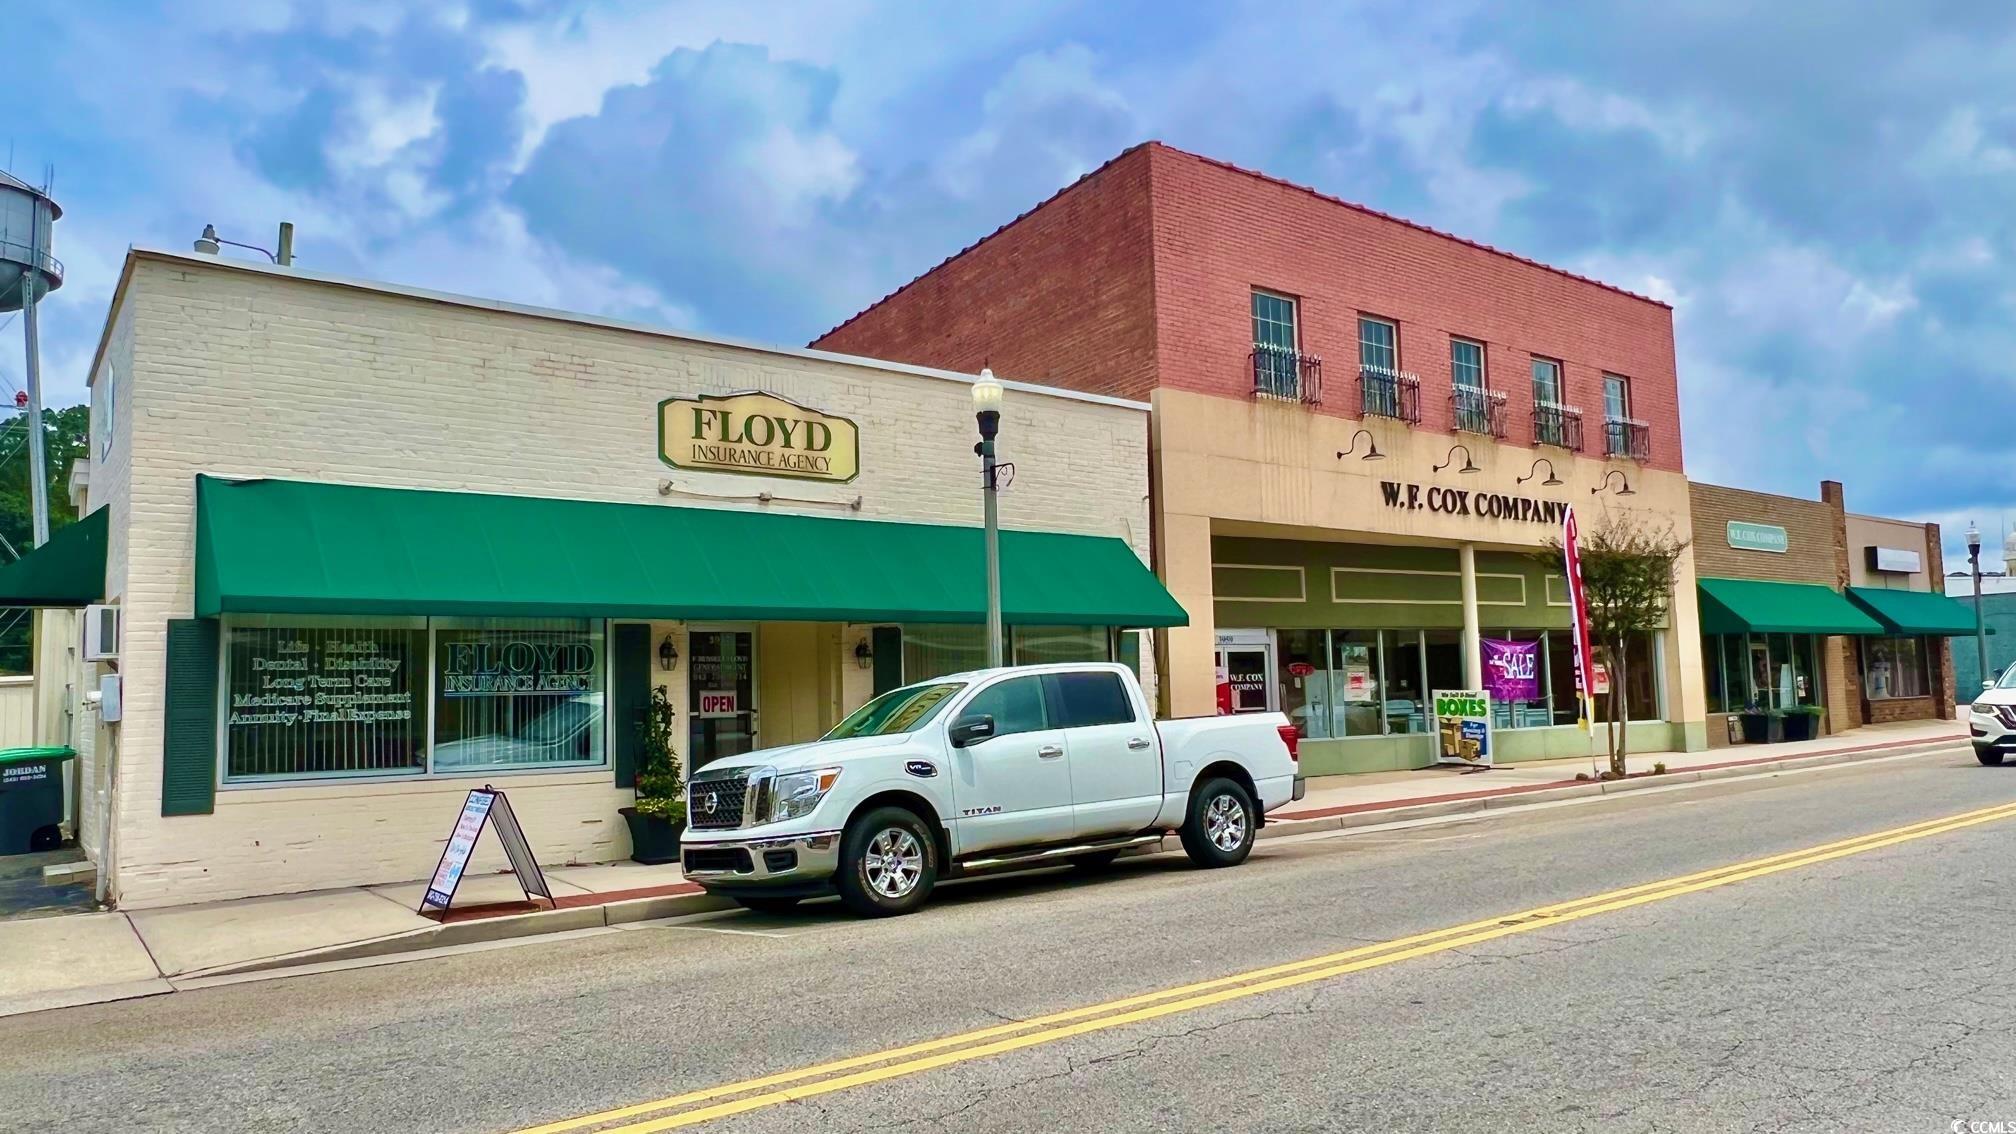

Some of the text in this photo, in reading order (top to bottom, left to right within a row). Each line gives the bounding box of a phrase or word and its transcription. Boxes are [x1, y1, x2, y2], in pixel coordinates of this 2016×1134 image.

[691, 407, 832, 452] FLOYD
[692, 444, 832, 472] INSURANCE AGENCY
[1380, 481, 1570, 526] W.F. COX COMPANY
[277, 641, 379, 653] Life Health
[252, 657, 401, 673] Dental Disability
[444, 641, 596, 675] FLOYD
[1503, 652, 1534, 679] SALE
[263, 674, 391, 691] Long Term Care
[444, 674, 596, 692] INSURANCE AGENCY
[1246, 673, 1264, 682] COX
[1230, 683, 1263, 691] COMPANY
[233, 691, 412, 707] Medicare Supplement
[703, 695, 735, 713] OPEN
[345, 708, 412, 724] Expense
[1436, 698, 1487, 718] BOXES
[2, 765, 47, 777] JORDAN
[962, 806, 1002, 816] TITAN
